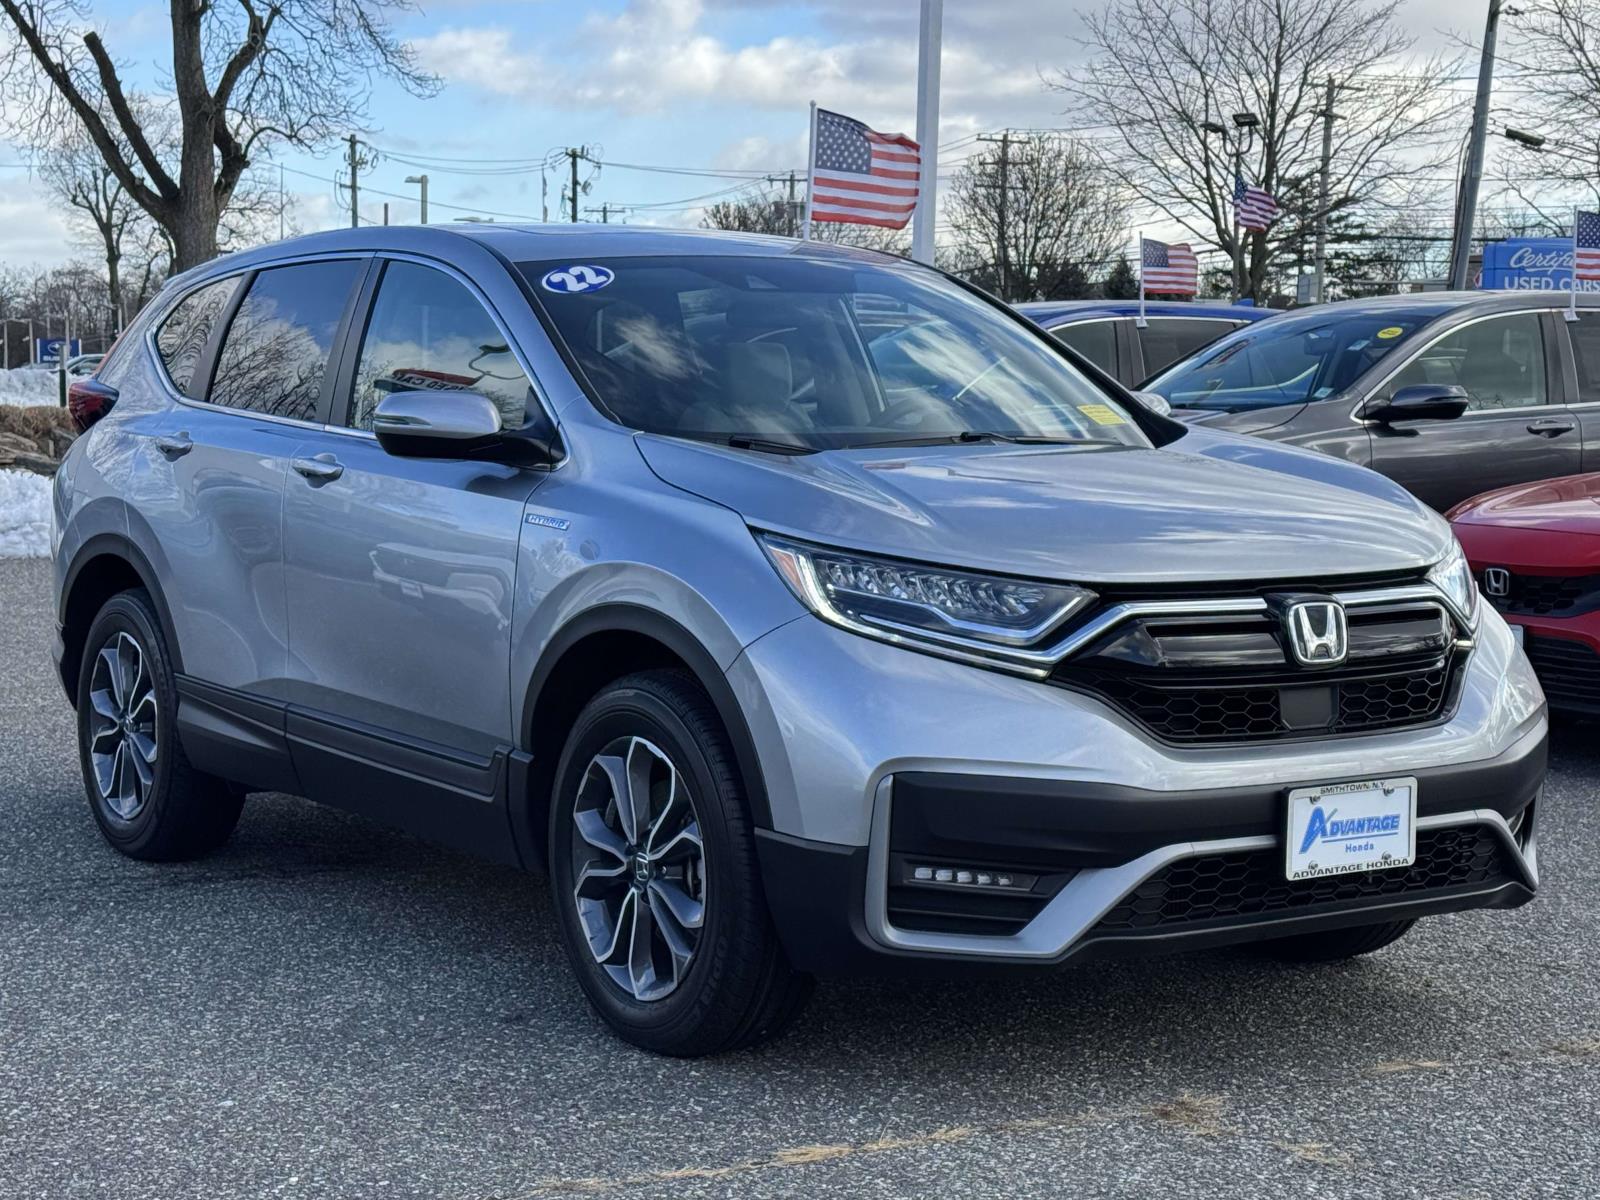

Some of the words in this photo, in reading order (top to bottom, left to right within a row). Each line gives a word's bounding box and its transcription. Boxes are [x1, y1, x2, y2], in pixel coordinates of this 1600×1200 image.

[1509, 247, 1573, 275] Certifi
[549, 265, 609, 292] 22
[1504, 276, 1554, 290] USED
[528, 515, 567, 529] HYBRID
[1299, 806, 1400, 854] ADVANTAGE
[1345, 841, 1374, 853] Honda
[1293, 862, 1363, 879] ADVANTAGE
[1366, 858, 1409, 869] HONDA
